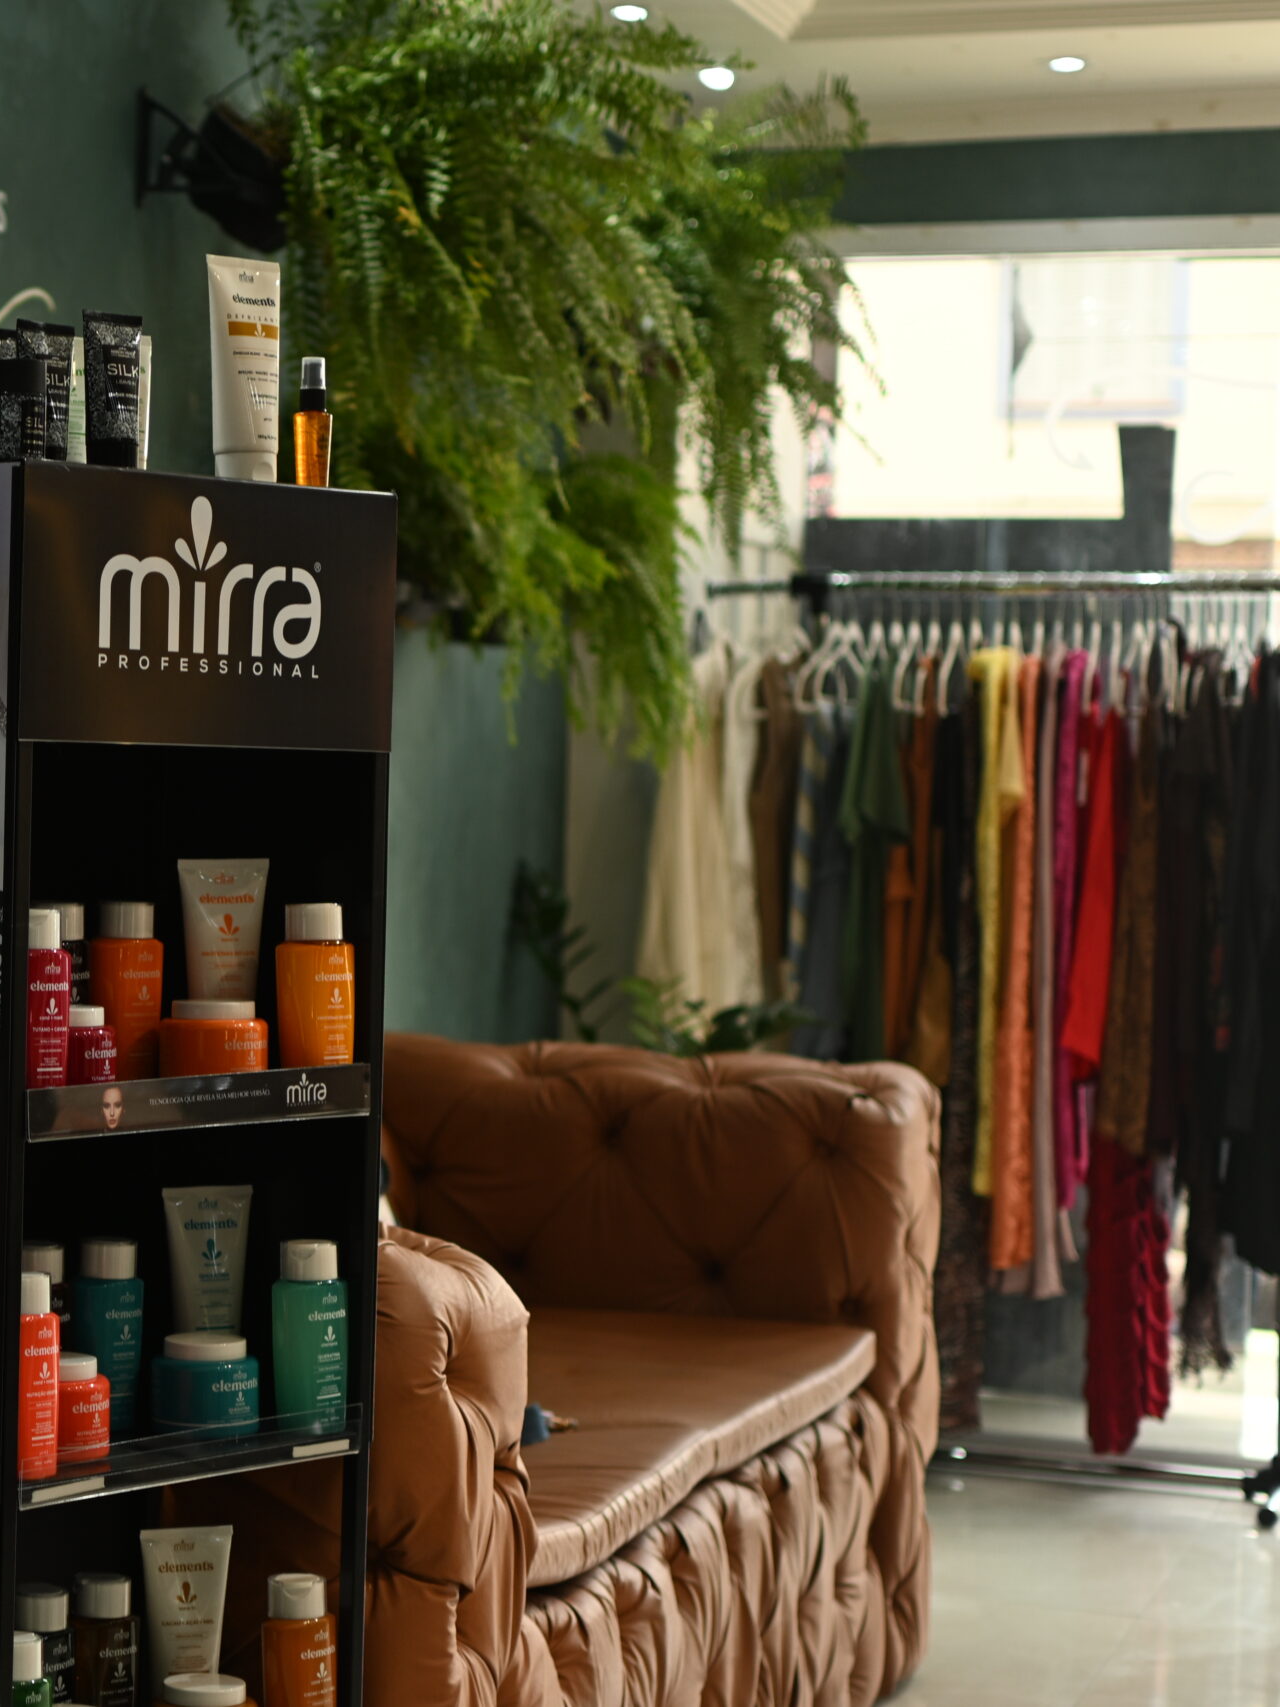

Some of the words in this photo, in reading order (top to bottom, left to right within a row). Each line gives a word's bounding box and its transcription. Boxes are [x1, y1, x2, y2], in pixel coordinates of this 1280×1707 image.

[232, 293, 276, 308] elements
[106, 363, 139, 378] SILK
[46, 372, 70, 387] SILK
[98, 496, 322, 660] mirra
[97, 652, 320, 680] PROFESSIONAL
[199, 893, 255, 904] elements
[84, 1047, 117, 1059] element
[286, 1072, 328, 1103] mirra
[149, 1096, 184, 1106] TECNOLOGIA
[185, 1095, 195, 1104] QUE
[196, 1093, 216, 1102] REVELA
[228, 1090, 249, 1099] MELHOR
[184, 1218, 238, 1231] elements
[308, 1308, 346, 1322] elements
[72, 1398, 110, 1414] element
[158, 1560, 214, 1574] elements
[44, 1657, 76, 1674] lements
